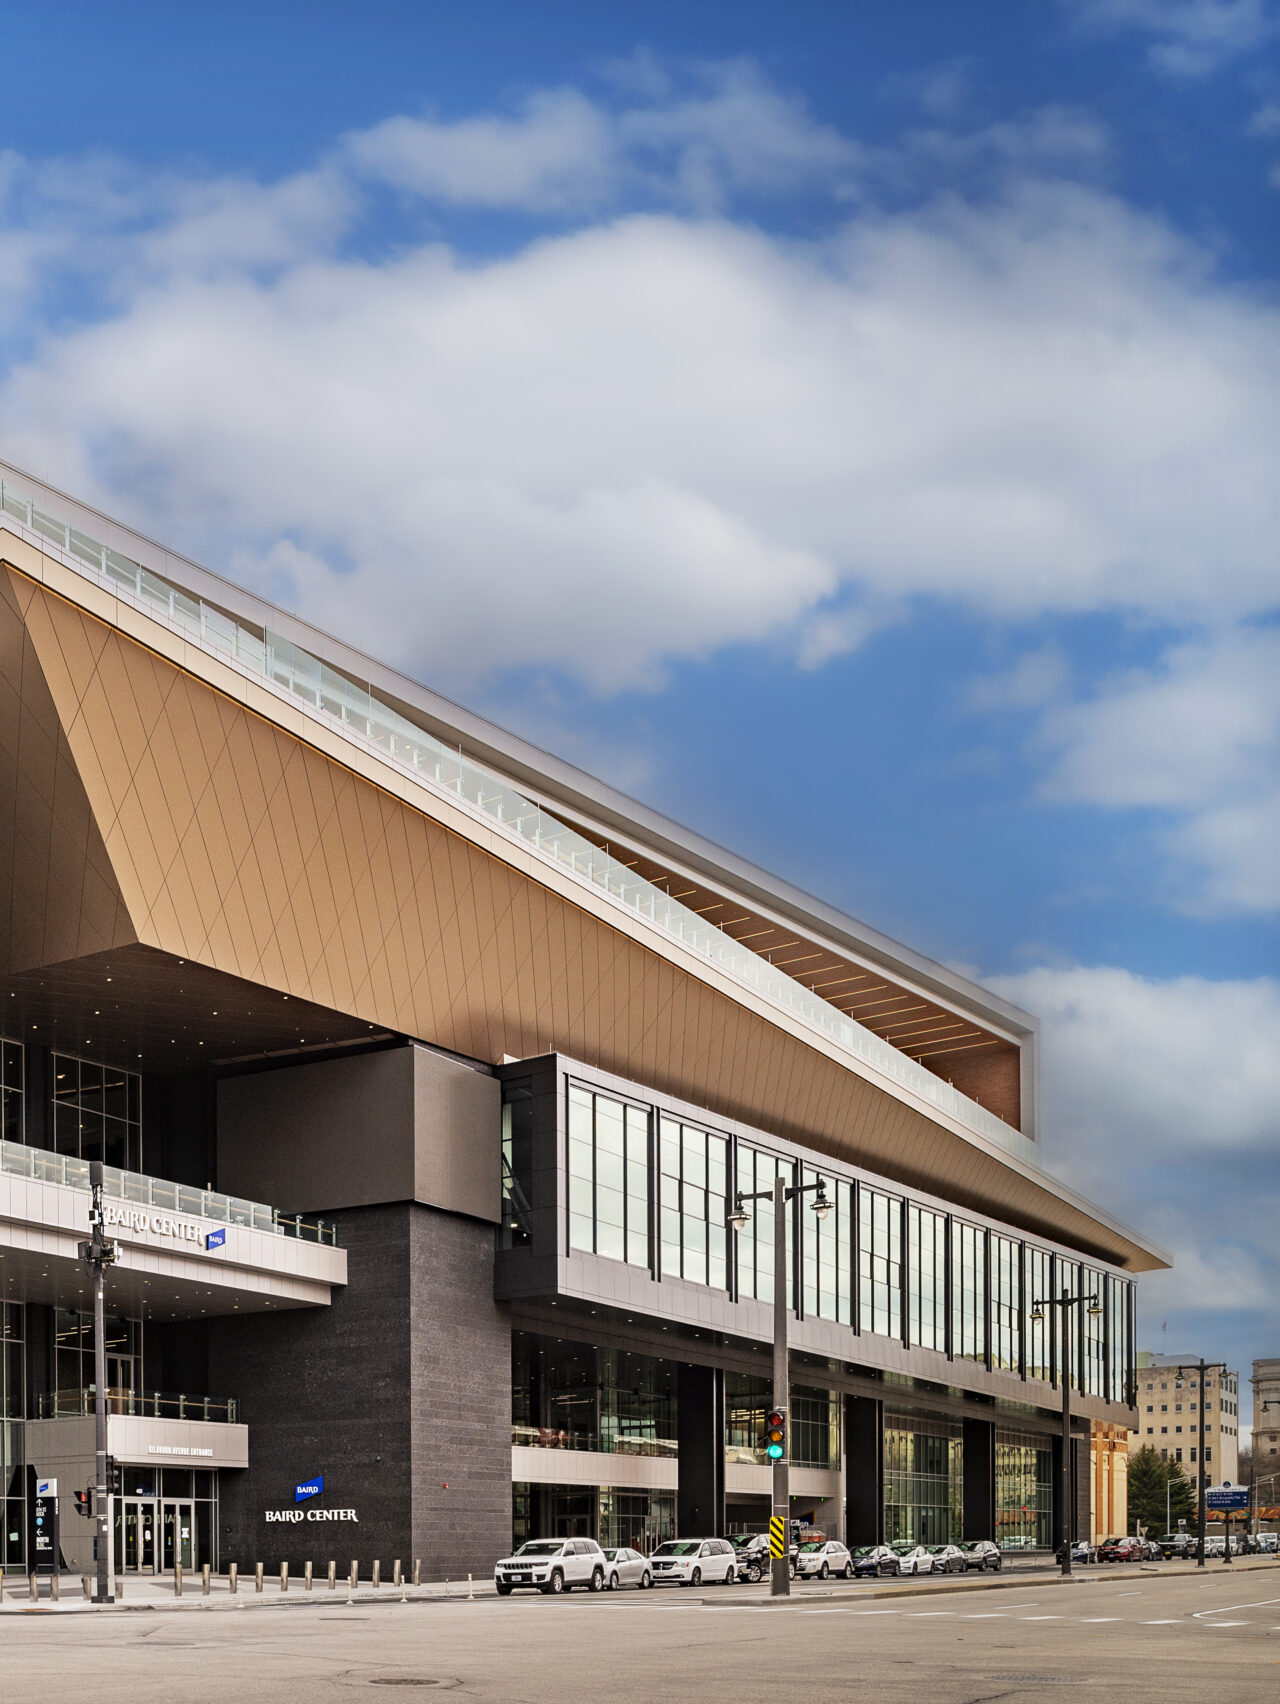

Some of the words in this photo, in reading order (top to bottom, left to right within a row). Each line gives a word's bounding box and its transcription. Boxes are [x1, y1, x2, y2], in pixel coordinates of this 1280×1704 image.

[106, 1206, 149, 1233] BAIRD
[150, 1216, 204, 1246] CENTER
[208, 1235, 223, 1244] BAIRD
[297, 1486, 319, 1494] BAIRD
[265, 1510, 305, 1523] BAIRD
[307, 1509, 359, 1522] CENTER
